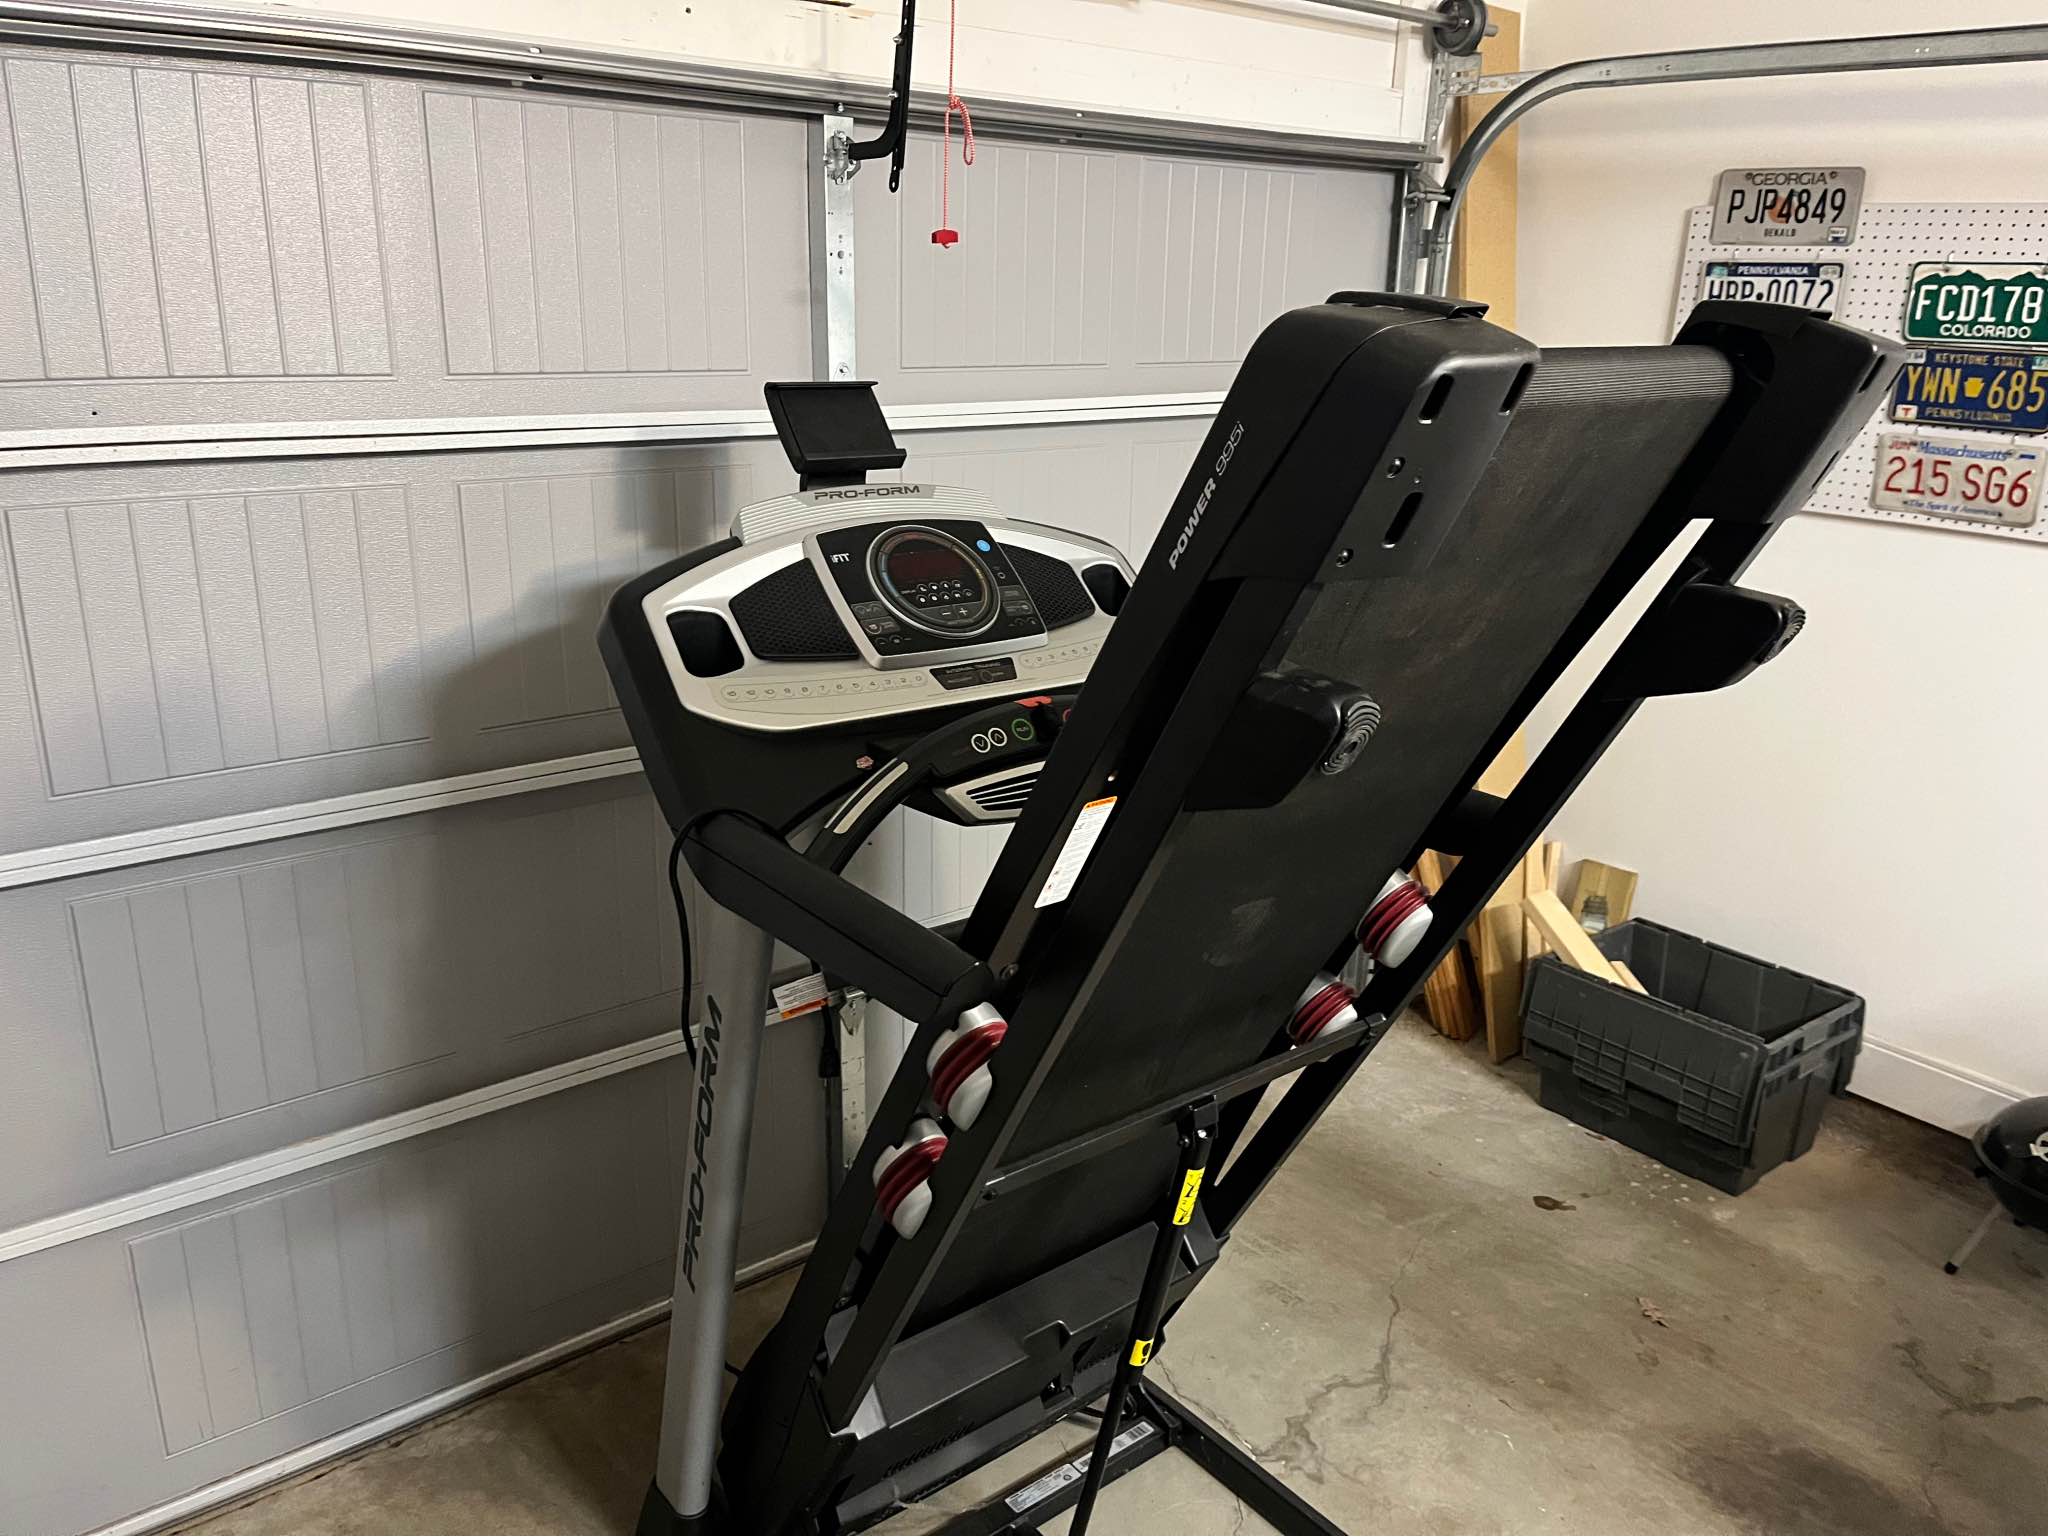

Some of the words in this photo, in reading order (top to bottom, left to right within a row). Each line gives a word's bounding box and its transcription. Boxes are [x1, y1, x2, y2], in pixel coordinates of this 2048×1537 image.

[1752, 172, 1828, 186] GEORGIA
[1727, 188, 1846, 224] PJP4849
[1737, 265, 1809, 275] PENNSYLVANIA
[1915, 284, 2044, 324] FCD178
[1940, 324, 2031, 339] COLORADO
[1993, 356, 2025, 368] STATE
[814, 485, 920, 500] PRO-FORM
[1884, 456, 1952, 497] 215
[1961, 463, 2033, 507] SG6
[1168, 477, 1217, 571] POWER
[683, 994, 722, 1295] PRO-FORM
